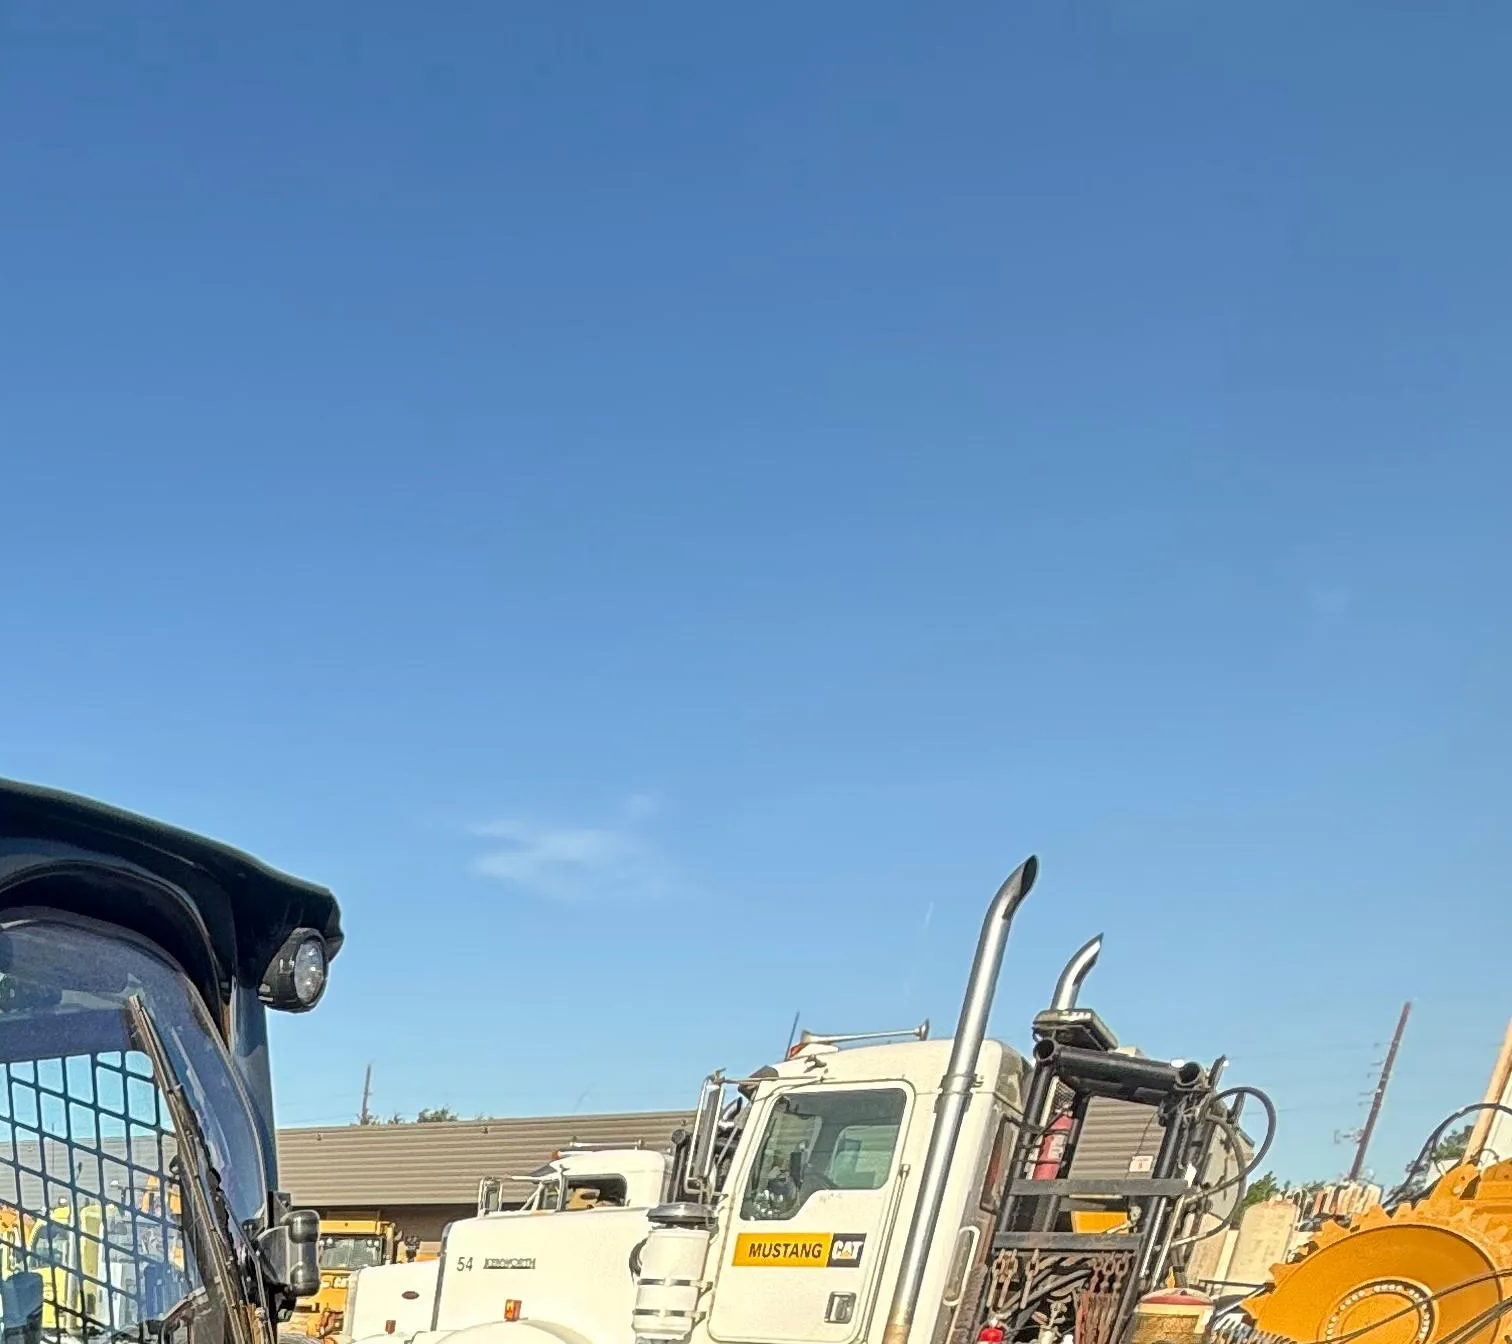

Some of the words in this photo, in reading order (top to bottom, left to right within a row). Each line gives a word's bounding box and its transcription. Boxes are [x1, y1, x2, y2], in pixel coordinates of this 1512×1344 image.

[748, 1242, 823, 1258] MUSTANG
[831, 1240, 863, 1260] CAT
[456, 1256, 473, 1271] 54
